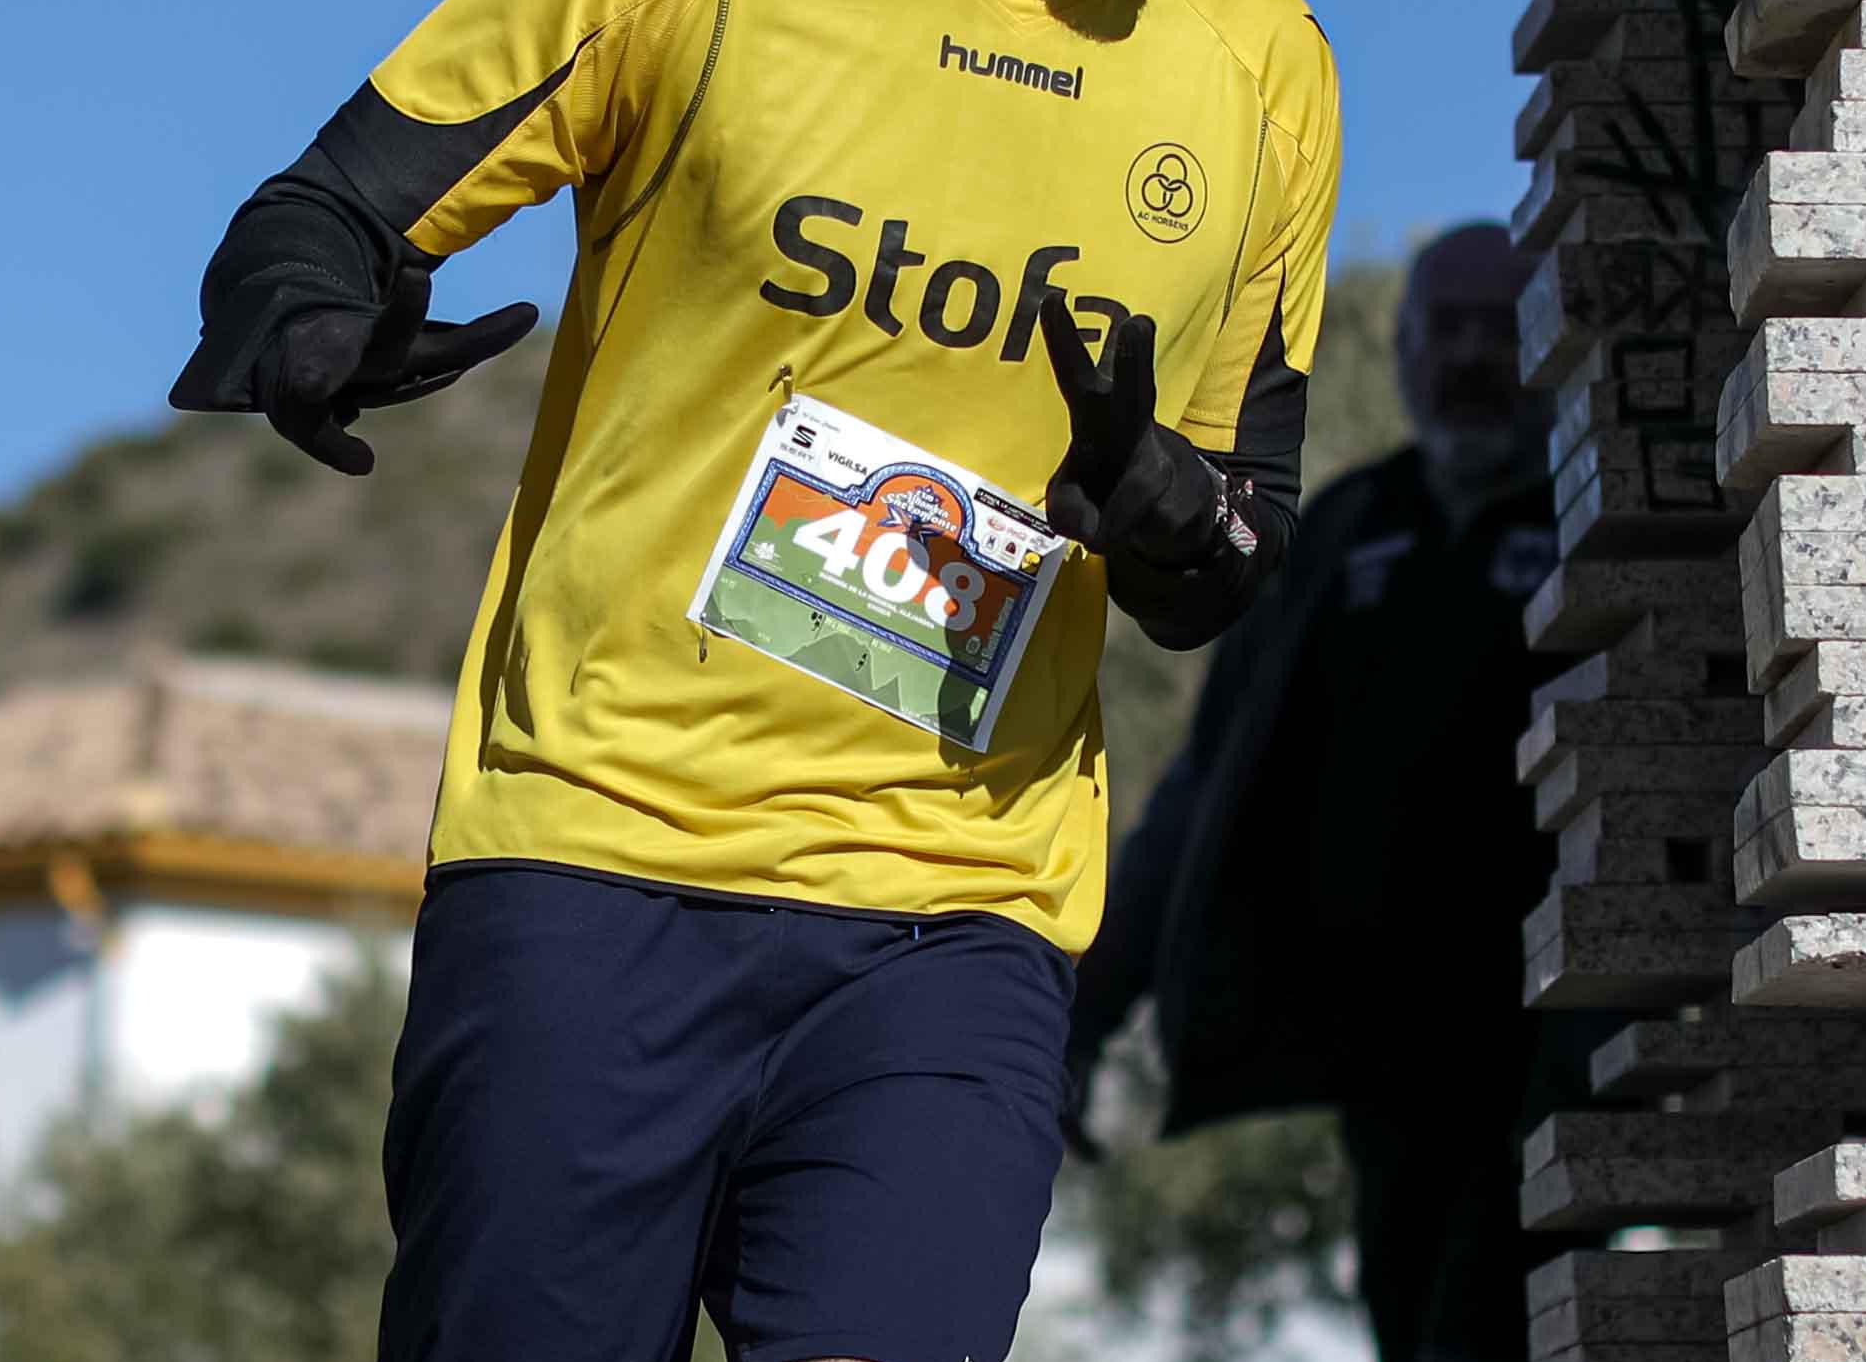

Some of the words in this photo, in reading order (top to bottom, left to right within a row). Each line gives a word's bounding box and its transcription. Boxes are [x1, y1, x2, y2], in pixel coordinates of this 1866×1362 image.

[939, 35, 1084, 100] hummel
[827, 449, 868, 476] VIGILSA
[792, 508, 985, 632] 408
